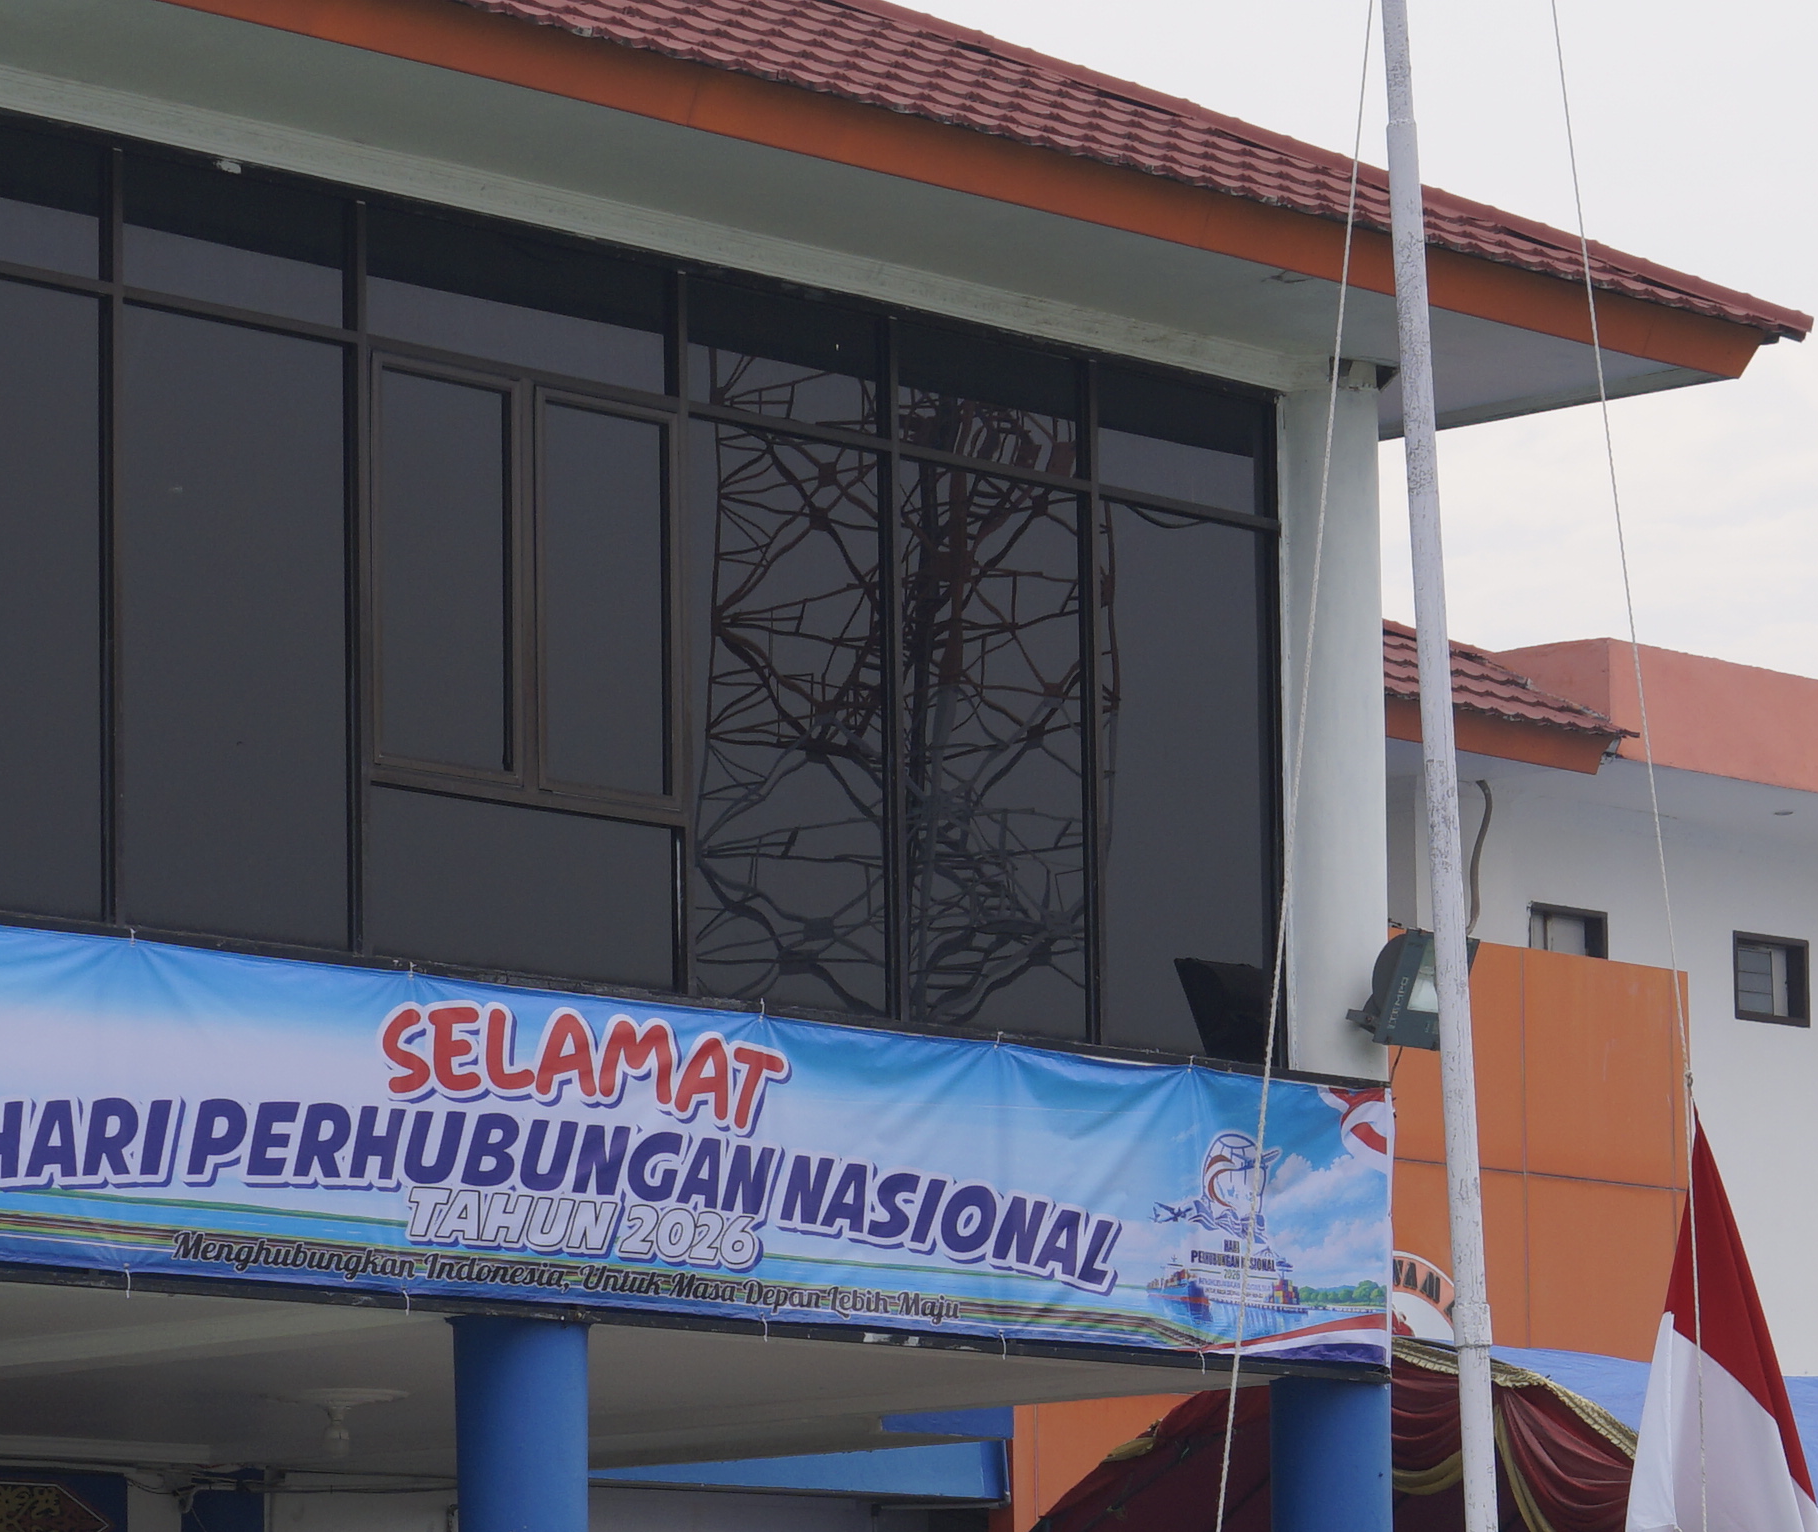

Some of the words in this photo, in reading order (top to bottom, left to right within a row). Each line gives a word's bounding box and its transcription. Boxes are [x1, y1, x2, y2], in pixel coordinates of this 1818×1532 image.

[382, 1007, 785, 1130] SELAMAT
[186, 1097, 777, 1218] PERHUBUNGAN
[779, 1154, 1114, 1287] NASIONAL
[408, 1186, 620, 1251] TAHUN
[619, 1203, 756, 1266] 2026
[174, 1232, 415, 1280] Menghubungkan
[426, 1253, 571, 1292] Indonesia,
[581, 1265, 670, 1296] Untuk
[669, 1272, 737, 1302] Masa
[743, 1279, 823, 1313] Depan
[827, 1286, 890, 1318] Lebih
[898, 1292, 961, 1324] Maju
